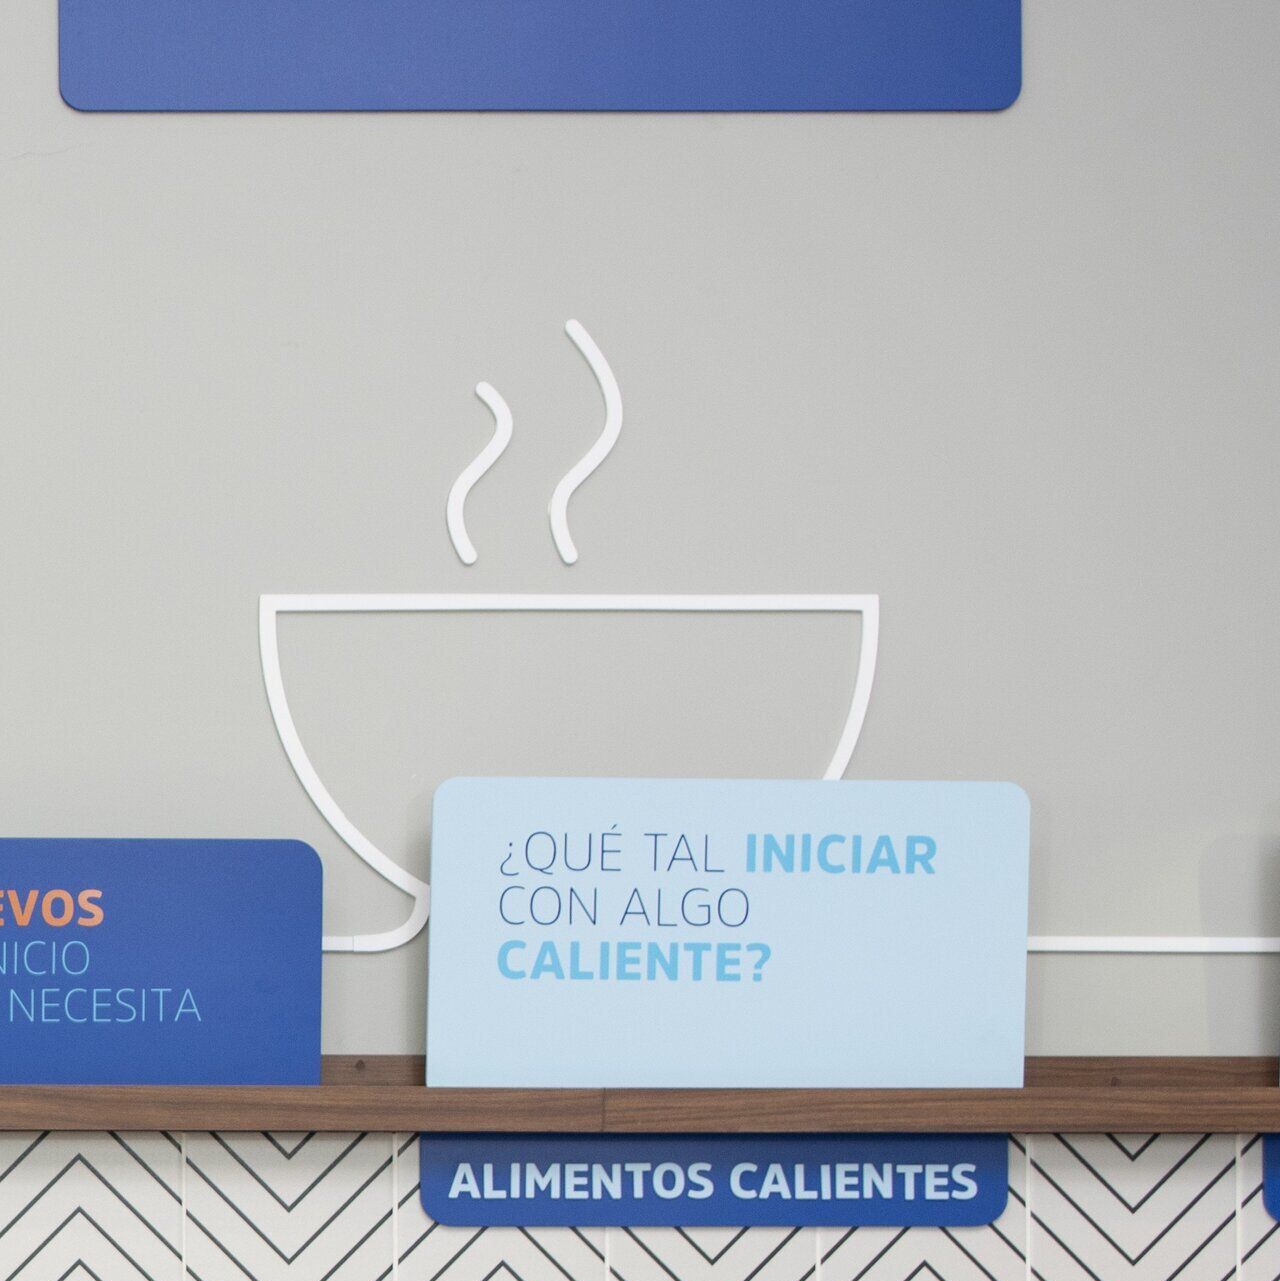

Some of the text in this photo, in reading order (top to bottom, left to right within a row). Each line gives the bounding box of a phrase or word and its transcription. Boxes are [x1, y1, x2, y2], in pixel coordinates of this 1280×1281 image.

[499, 824, 938, 877] ¿QUÉ TAL INICIAR
[498, 885, 751, 928] CON ALGO
[497, 940, 772, 983] CALIENTE?
[9, 988, 202, 1023] NECESITA
[448, 1161, 978, 1202] ALIMENTOS CALIENTES
